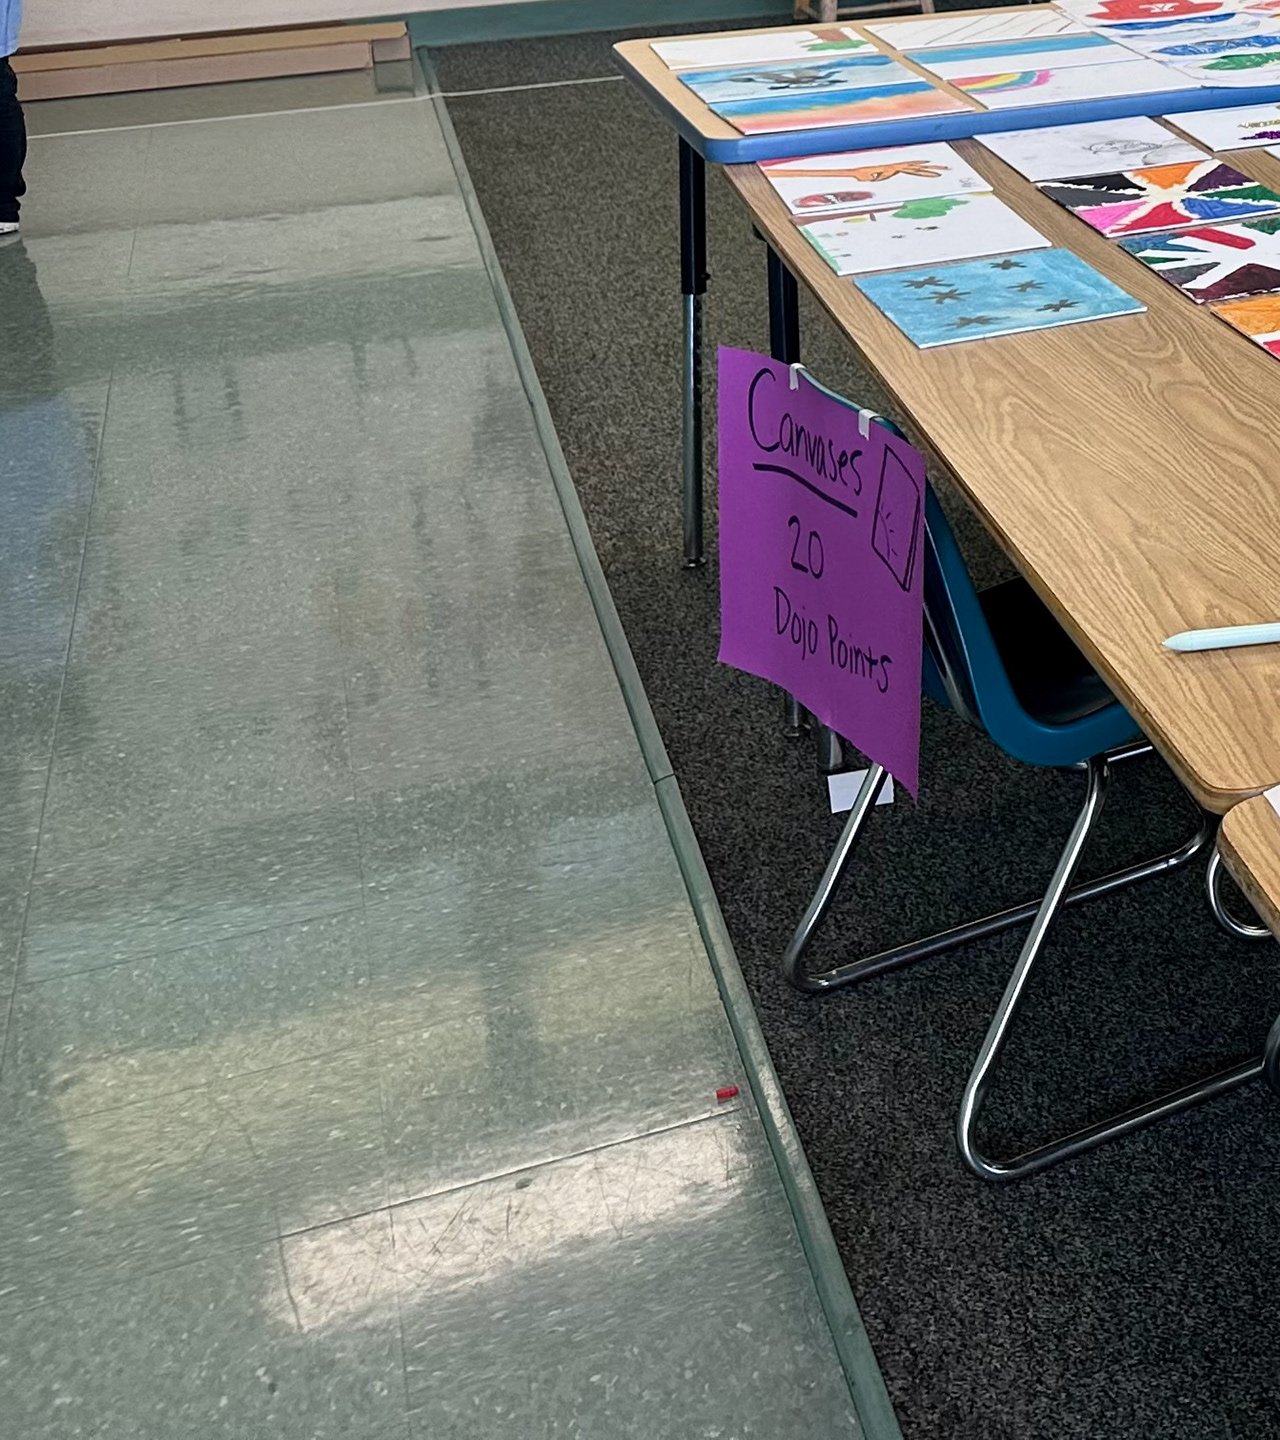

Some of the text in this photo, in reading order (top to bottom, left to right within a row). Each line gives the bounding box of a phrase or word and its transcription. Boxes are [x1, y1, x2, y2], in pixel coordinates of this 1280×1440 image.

[748, 366, 863, 497] Canvases
[788, 515, 824, 580] 20
[773, 585, 893, 694] Dojo Points
